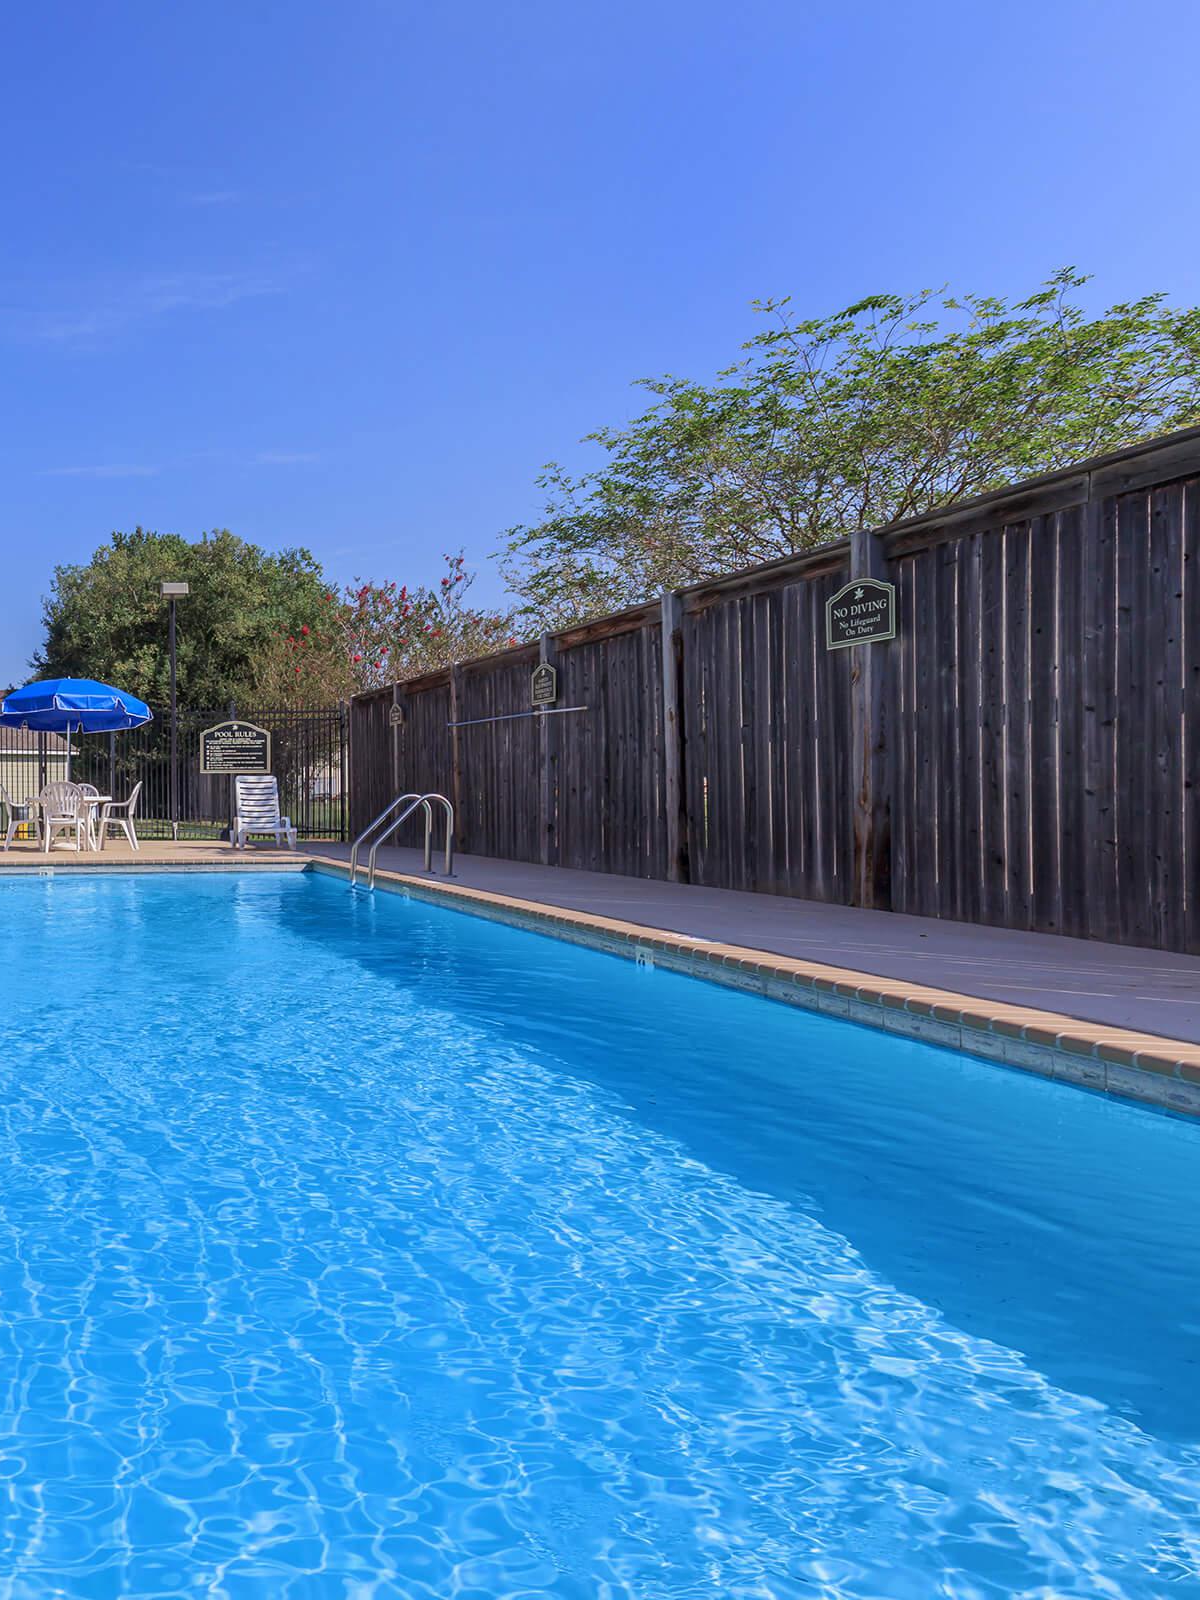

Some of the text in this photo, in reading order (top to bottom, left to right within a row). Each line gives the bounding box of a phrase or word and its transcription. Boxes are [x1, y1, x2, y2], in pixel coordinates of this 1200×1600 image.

[833, 599, 887, 619] NO DIVING
[840, 614, 880, 629] No Lifeguard
[845, 626, 873, 637] On Duty
